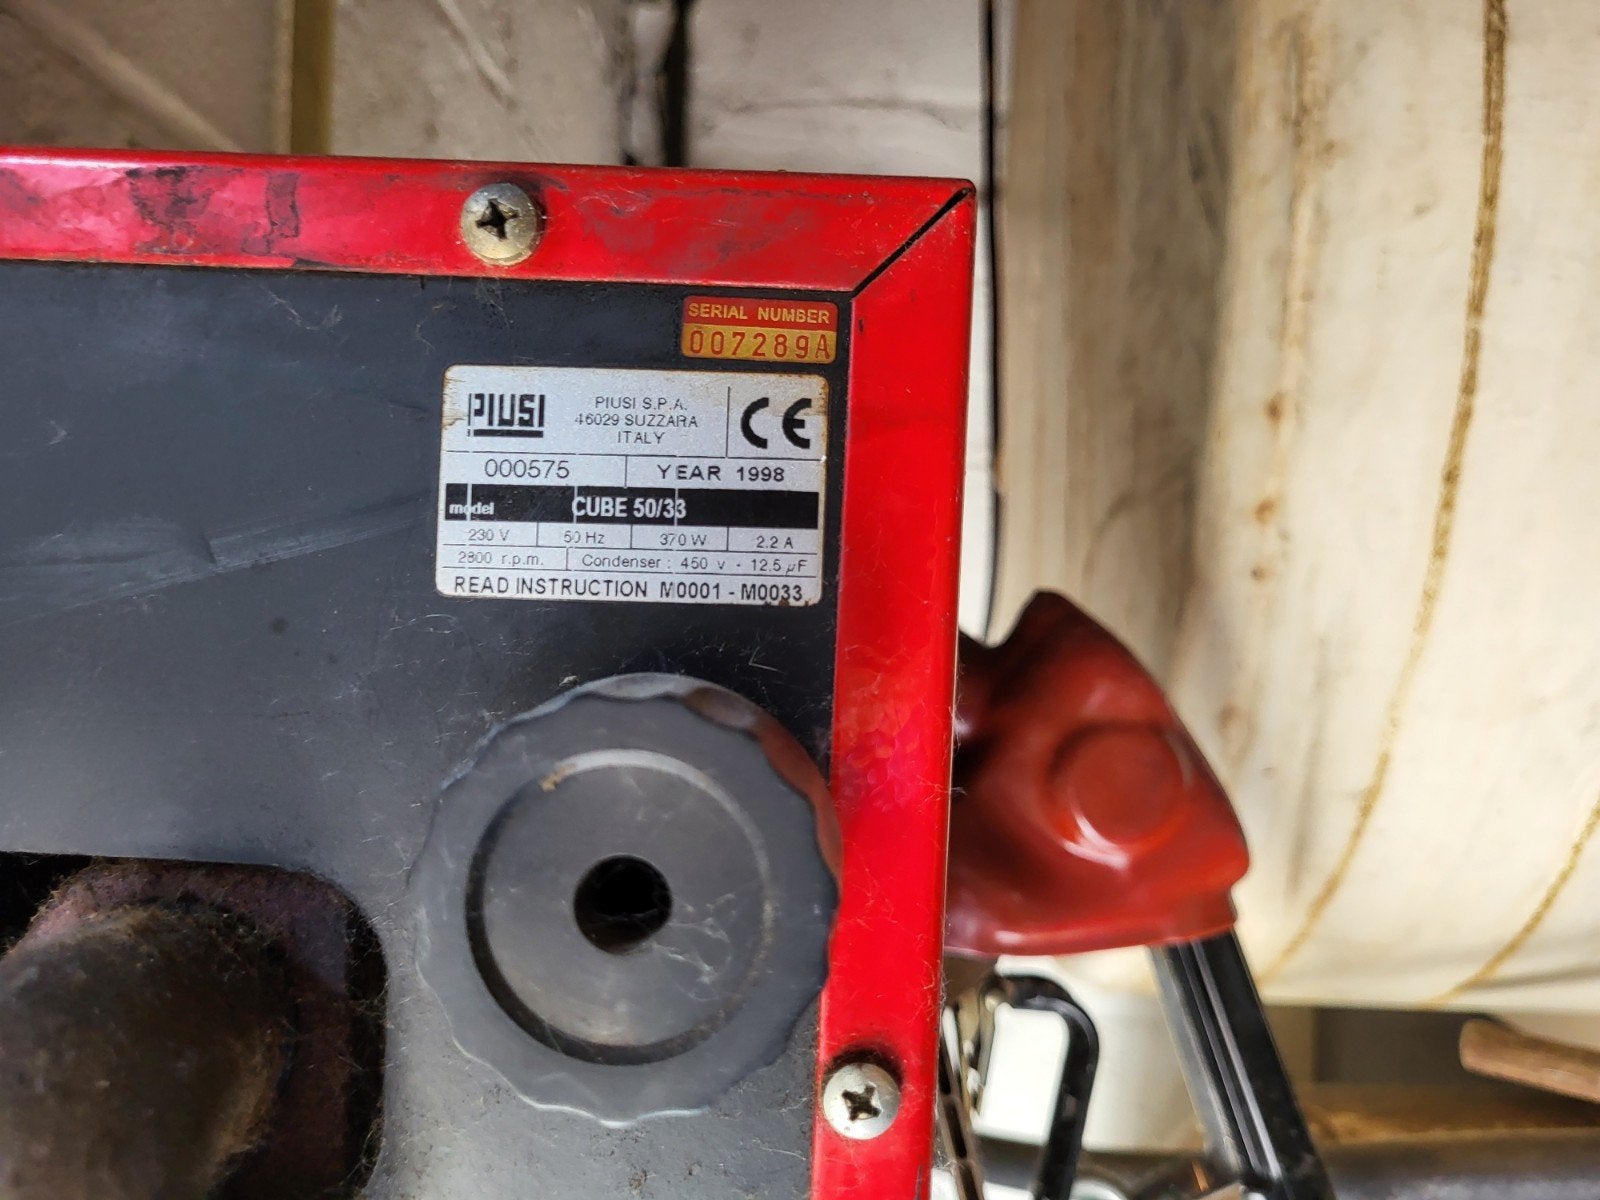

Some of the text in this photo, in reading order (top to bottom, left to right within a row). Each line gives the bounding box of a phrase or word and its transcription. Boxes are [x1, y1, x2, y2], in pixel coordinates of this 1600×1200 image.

[688, 302, 830, 324] SERIAL NUMBER
[690, 329, 830, 359] 007289A
[468, 393, 545, 427] PIUSI
[595, 396, 688, 411] PIUSI S.P.A.
[575, 413, 698, 428] 46029 SUZZARA
[617, 430, 665, 445] ITALY
[484, 458, 570, 479] 000575
[657, 464, 785, 482] YEAR 1998
[449, 502, 495, 515] model
[571, 496, 687, 518] CUBE 50/33
[468, 528, 510, 541] 230 V
[563, 531, 605, 544] 50 Hz
[659, 533, 707, 546] 370 W
[756, 536, 793, 549] 2.2 A
[501, 554, 544, 567] r.p.m.
[582, 554, 661, 568] Condenser
[681, 557, 708, 570] 450
[751, 559, 781, 571] 12.5
[455, 576, 647, 598] READ INSTRUCTION
[660, 582, 720, 599] M0001
[741, 584, 803, 601] M0033
